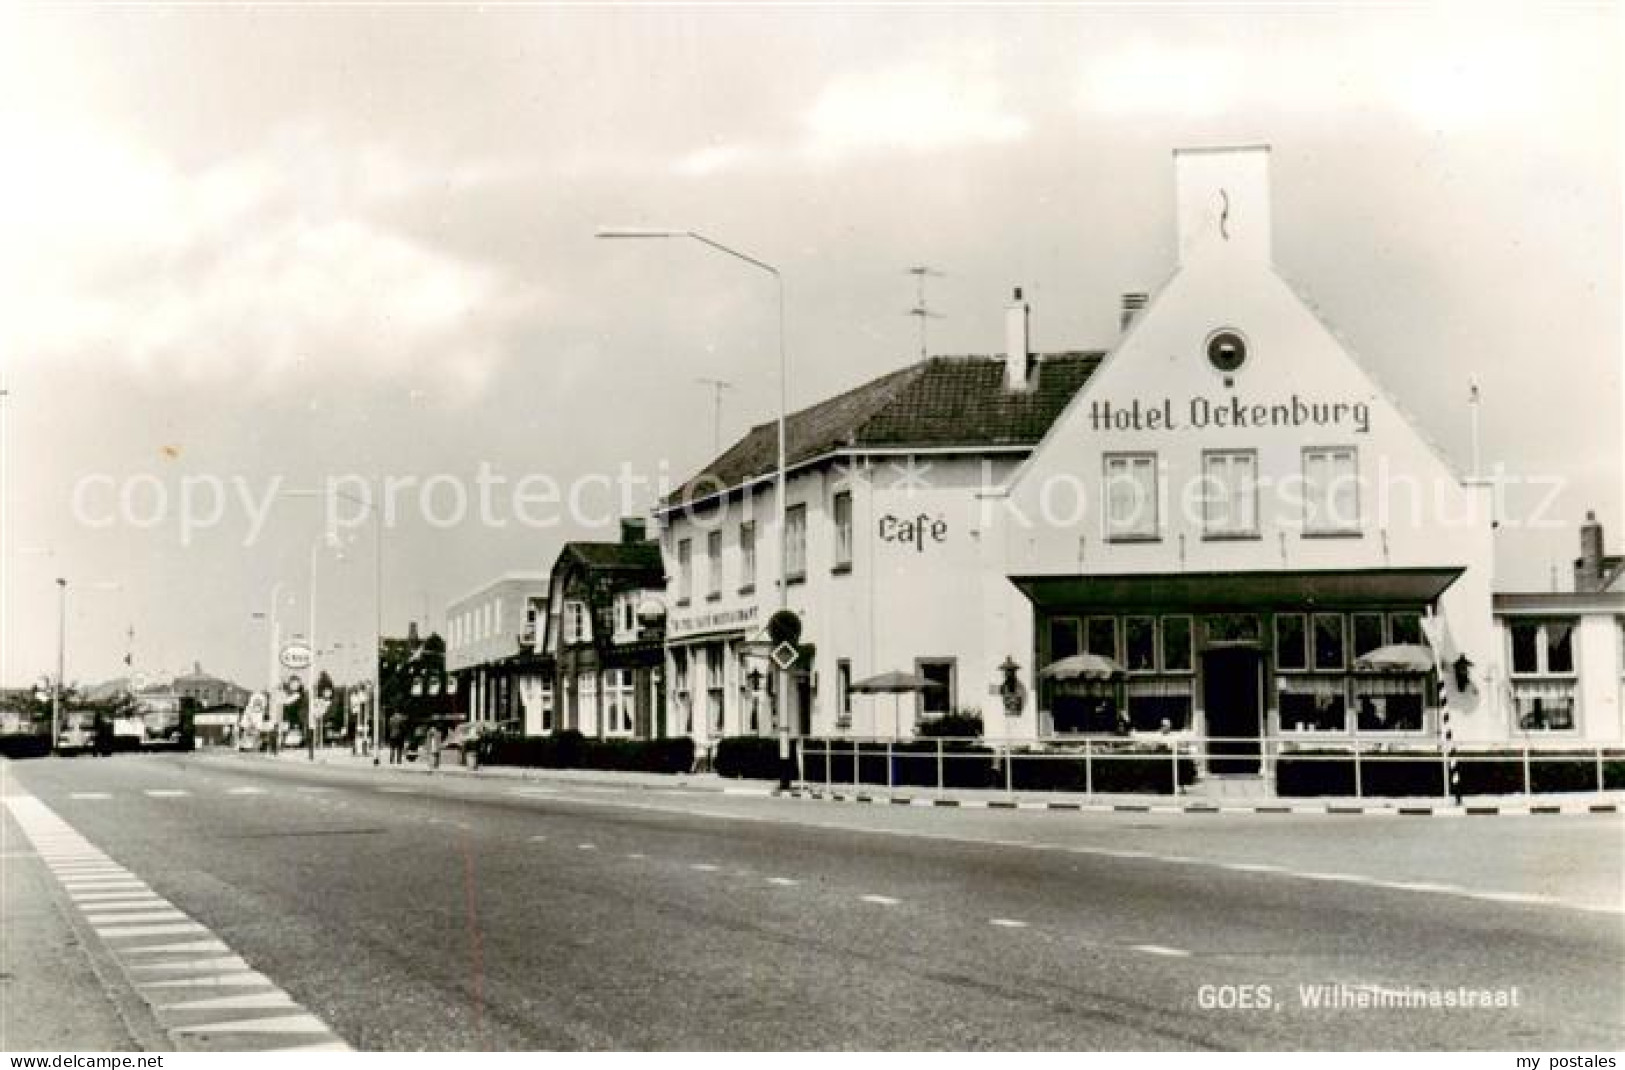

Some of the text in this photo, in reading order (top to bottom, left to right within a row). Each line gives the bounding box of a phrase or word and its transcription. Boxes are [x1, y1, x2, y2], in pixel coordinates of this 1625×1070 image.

[1090, 396, 1371, 433] Hotel Ockenburg
[878, 513, 949, 552] Café
